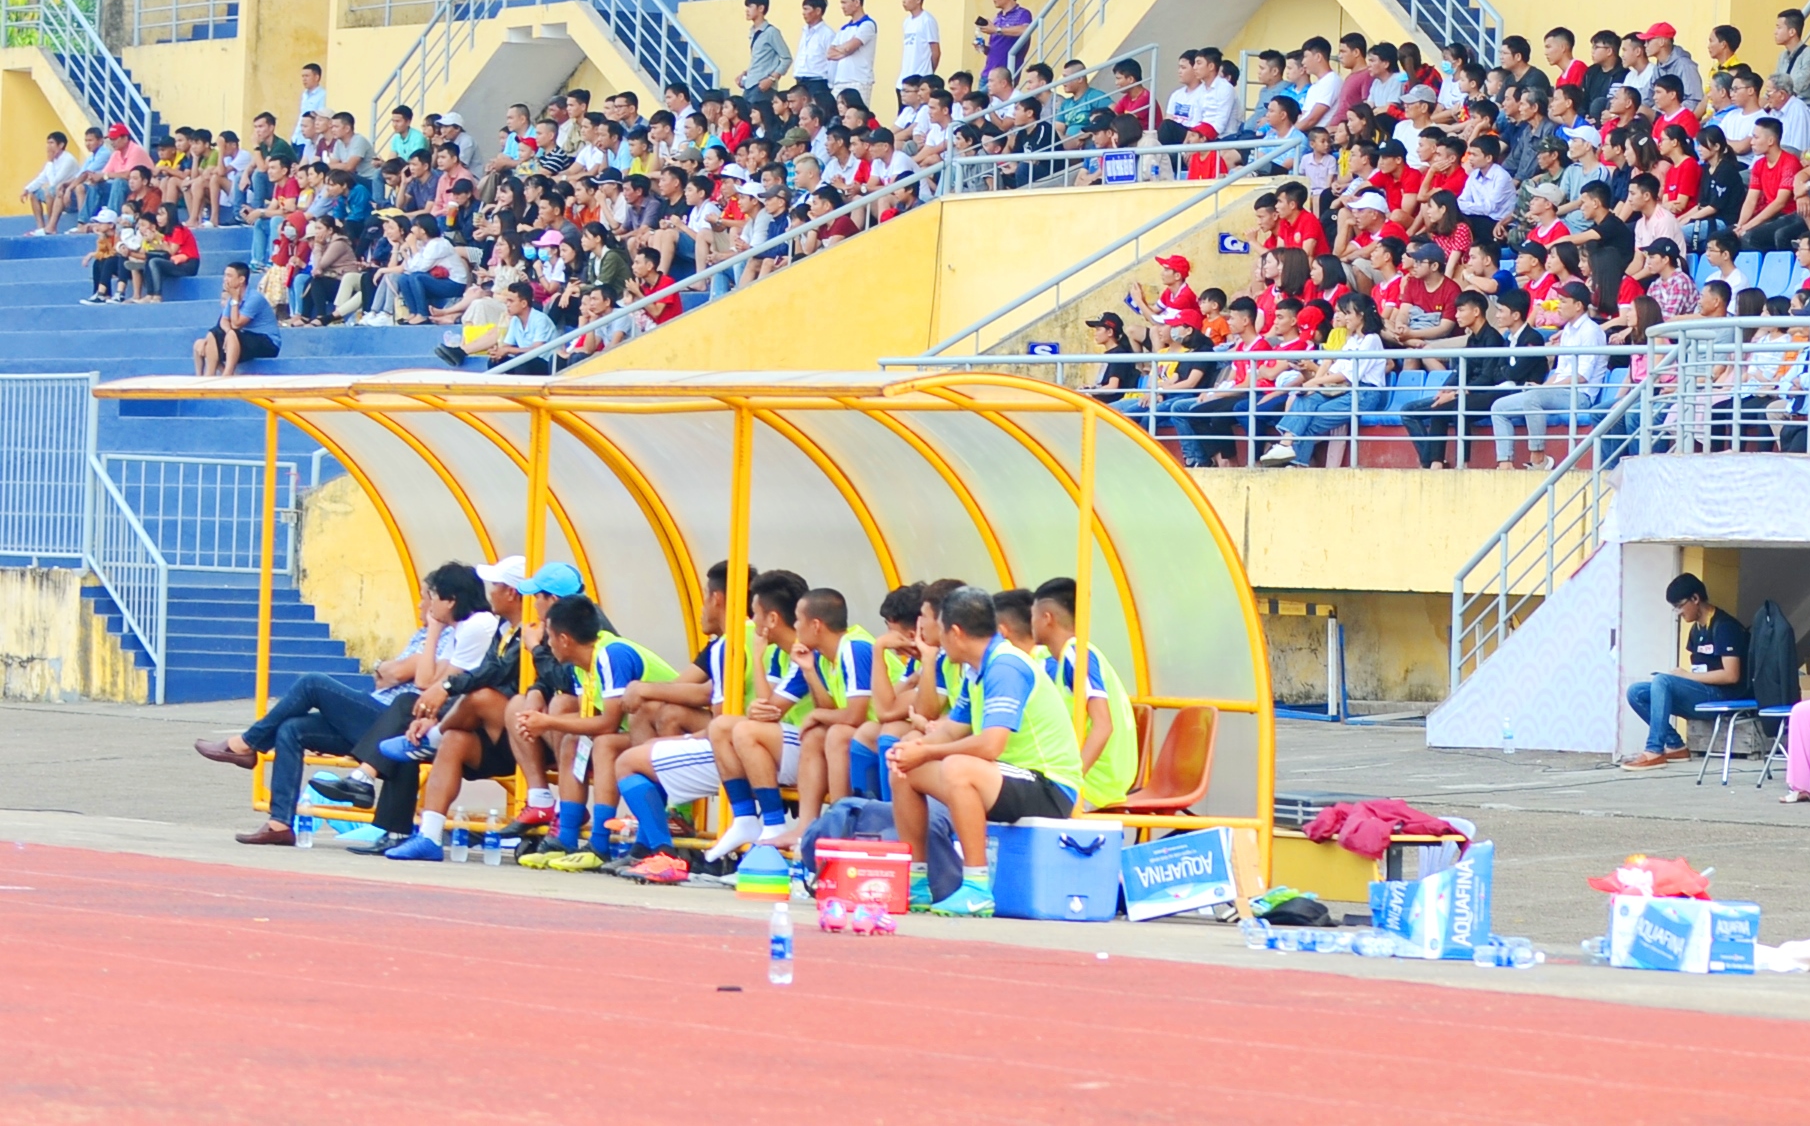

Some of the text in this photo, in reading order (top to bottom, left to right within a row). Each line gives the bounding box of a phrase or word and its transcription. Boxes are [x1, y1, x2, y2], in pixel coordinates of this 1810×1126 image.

[1224, 235, 1245, 252] Q
[1133, 850, 1213, 888] AQUAFINA
[1451, 857, 1475, 947] AQUAFINA
